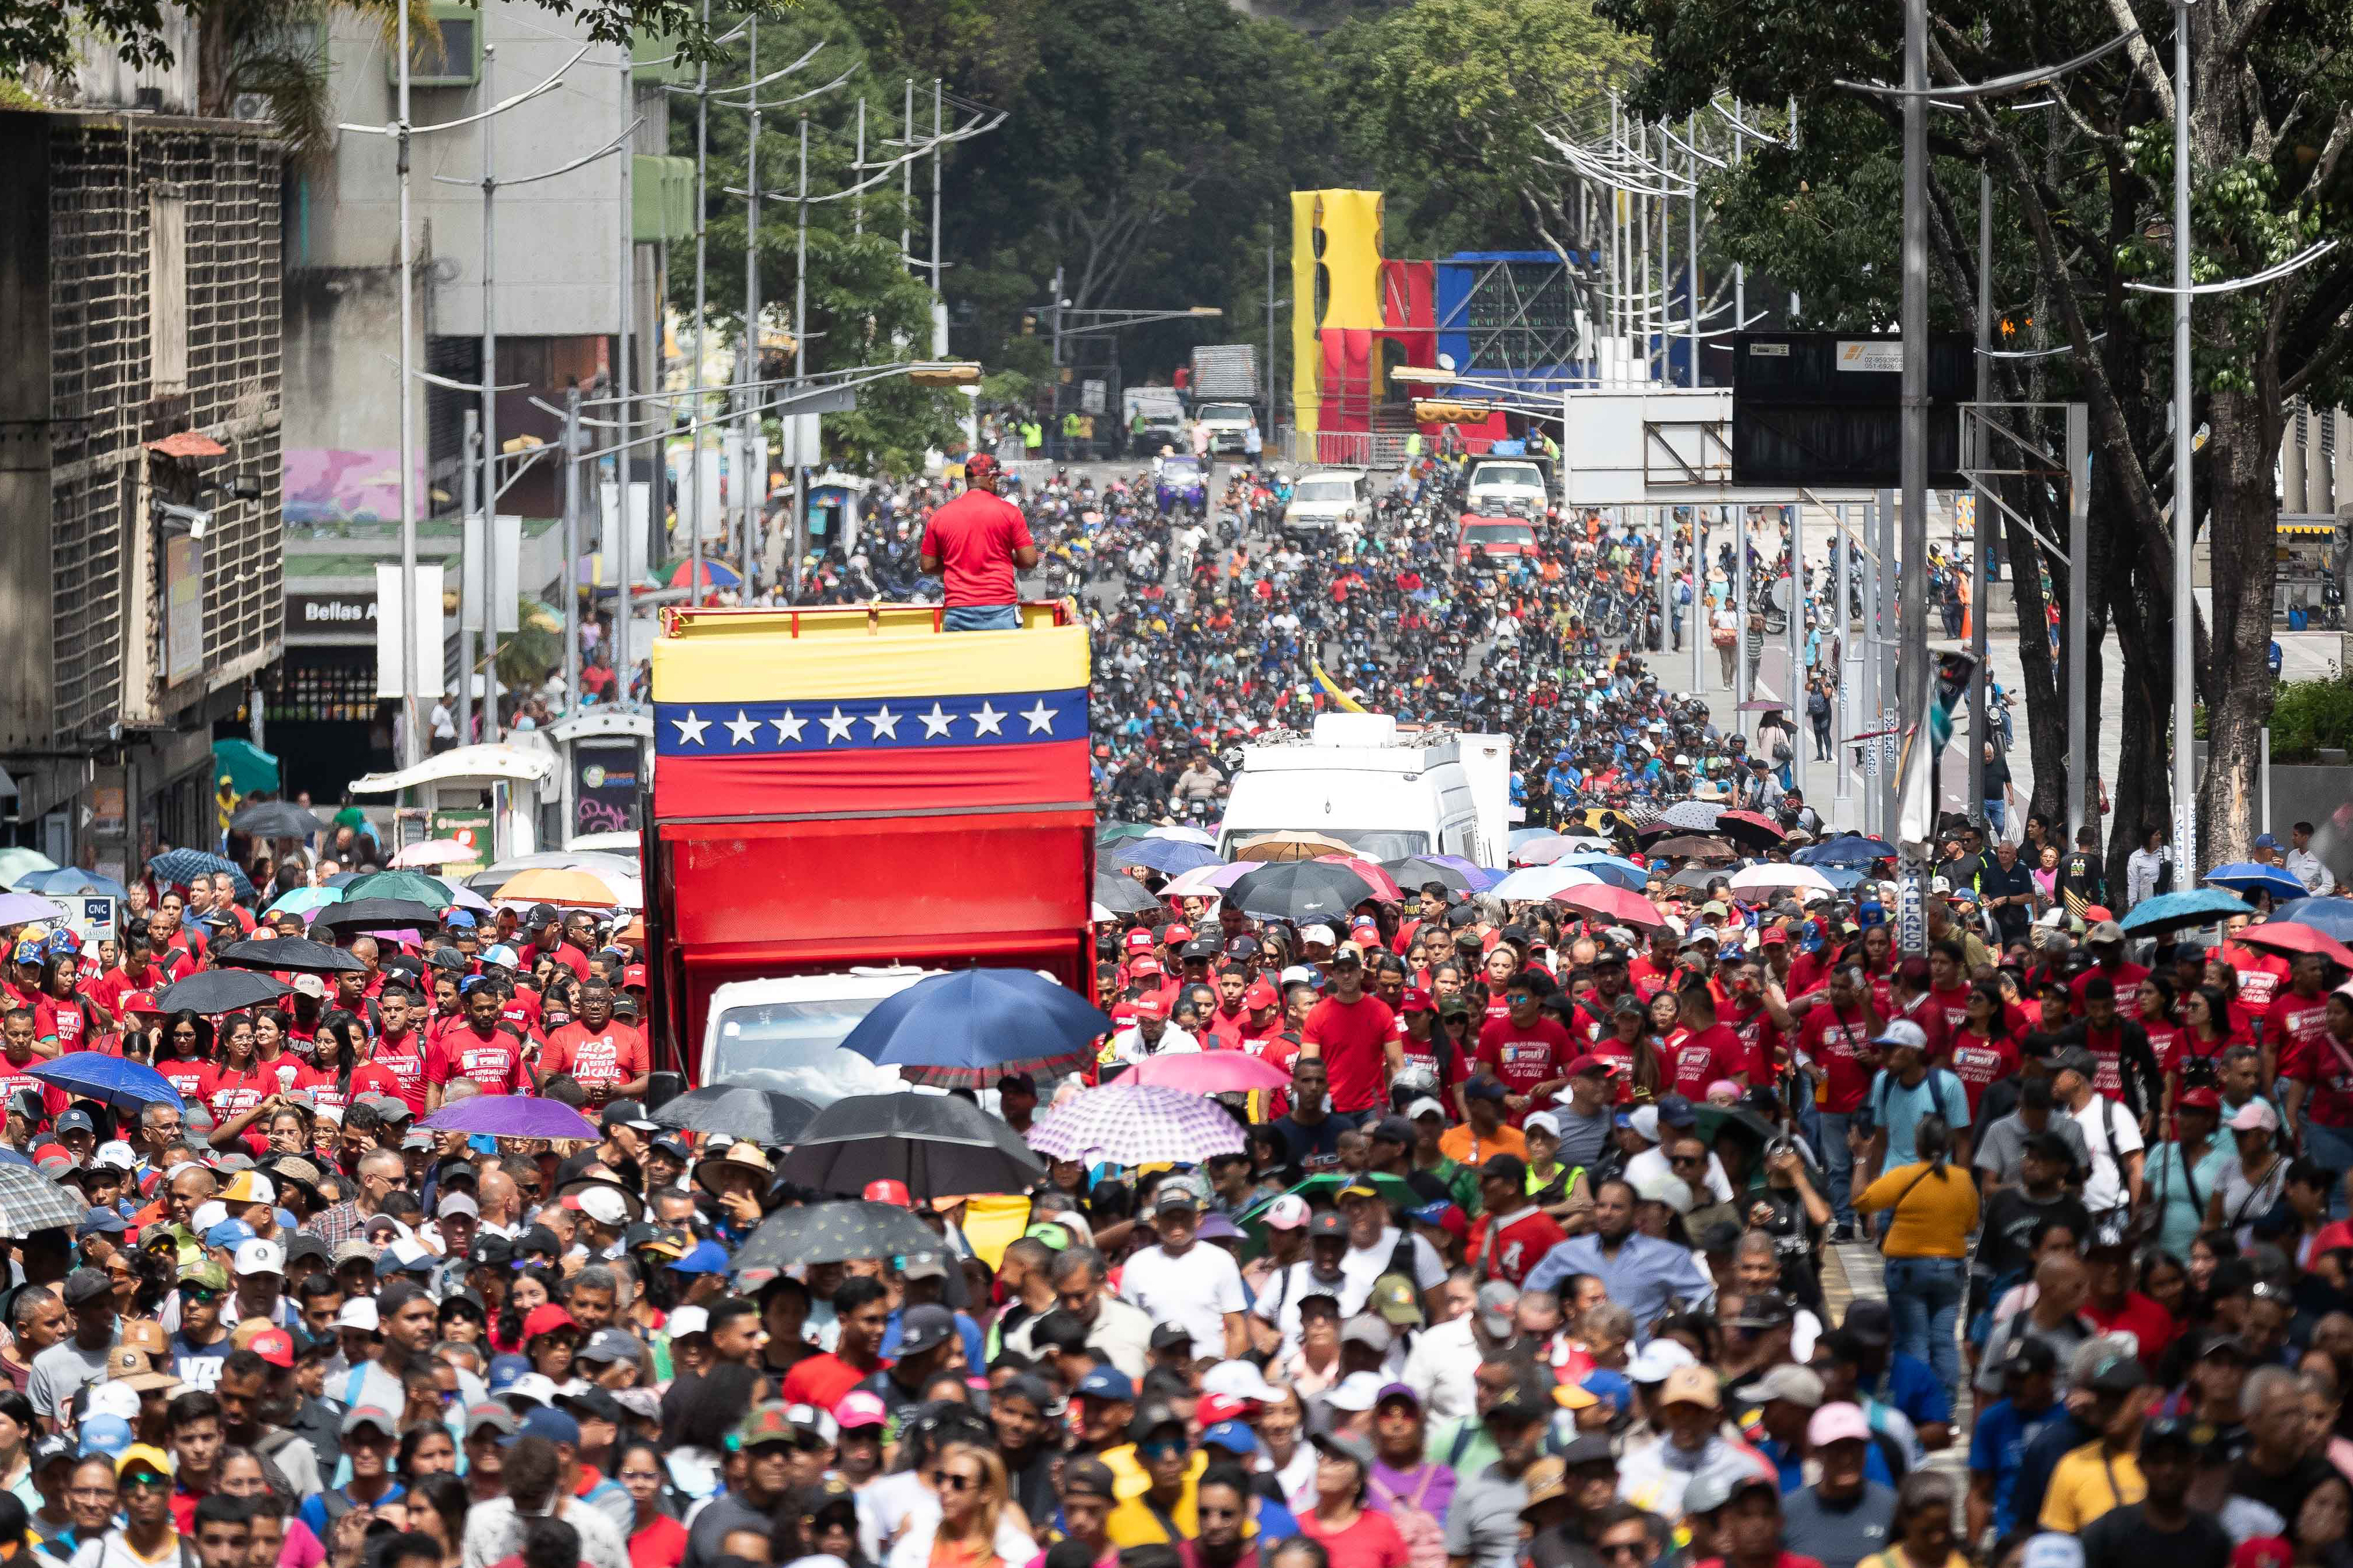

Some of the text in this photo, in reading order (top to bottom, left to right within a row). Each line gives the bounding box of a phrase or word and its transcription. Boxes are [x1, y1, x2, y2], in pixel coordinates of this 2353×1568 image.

[306, 601, 362, 621] Bellas
[88, 904, 107, 915] CNC
[1905, 897, 1922, 949] BLANCO
[479, 1054, 505, 1066] PSUV
[1519, 1048, 1545, 1060] PSUV
[572, 1060, 621, 1078] LA CALLE
